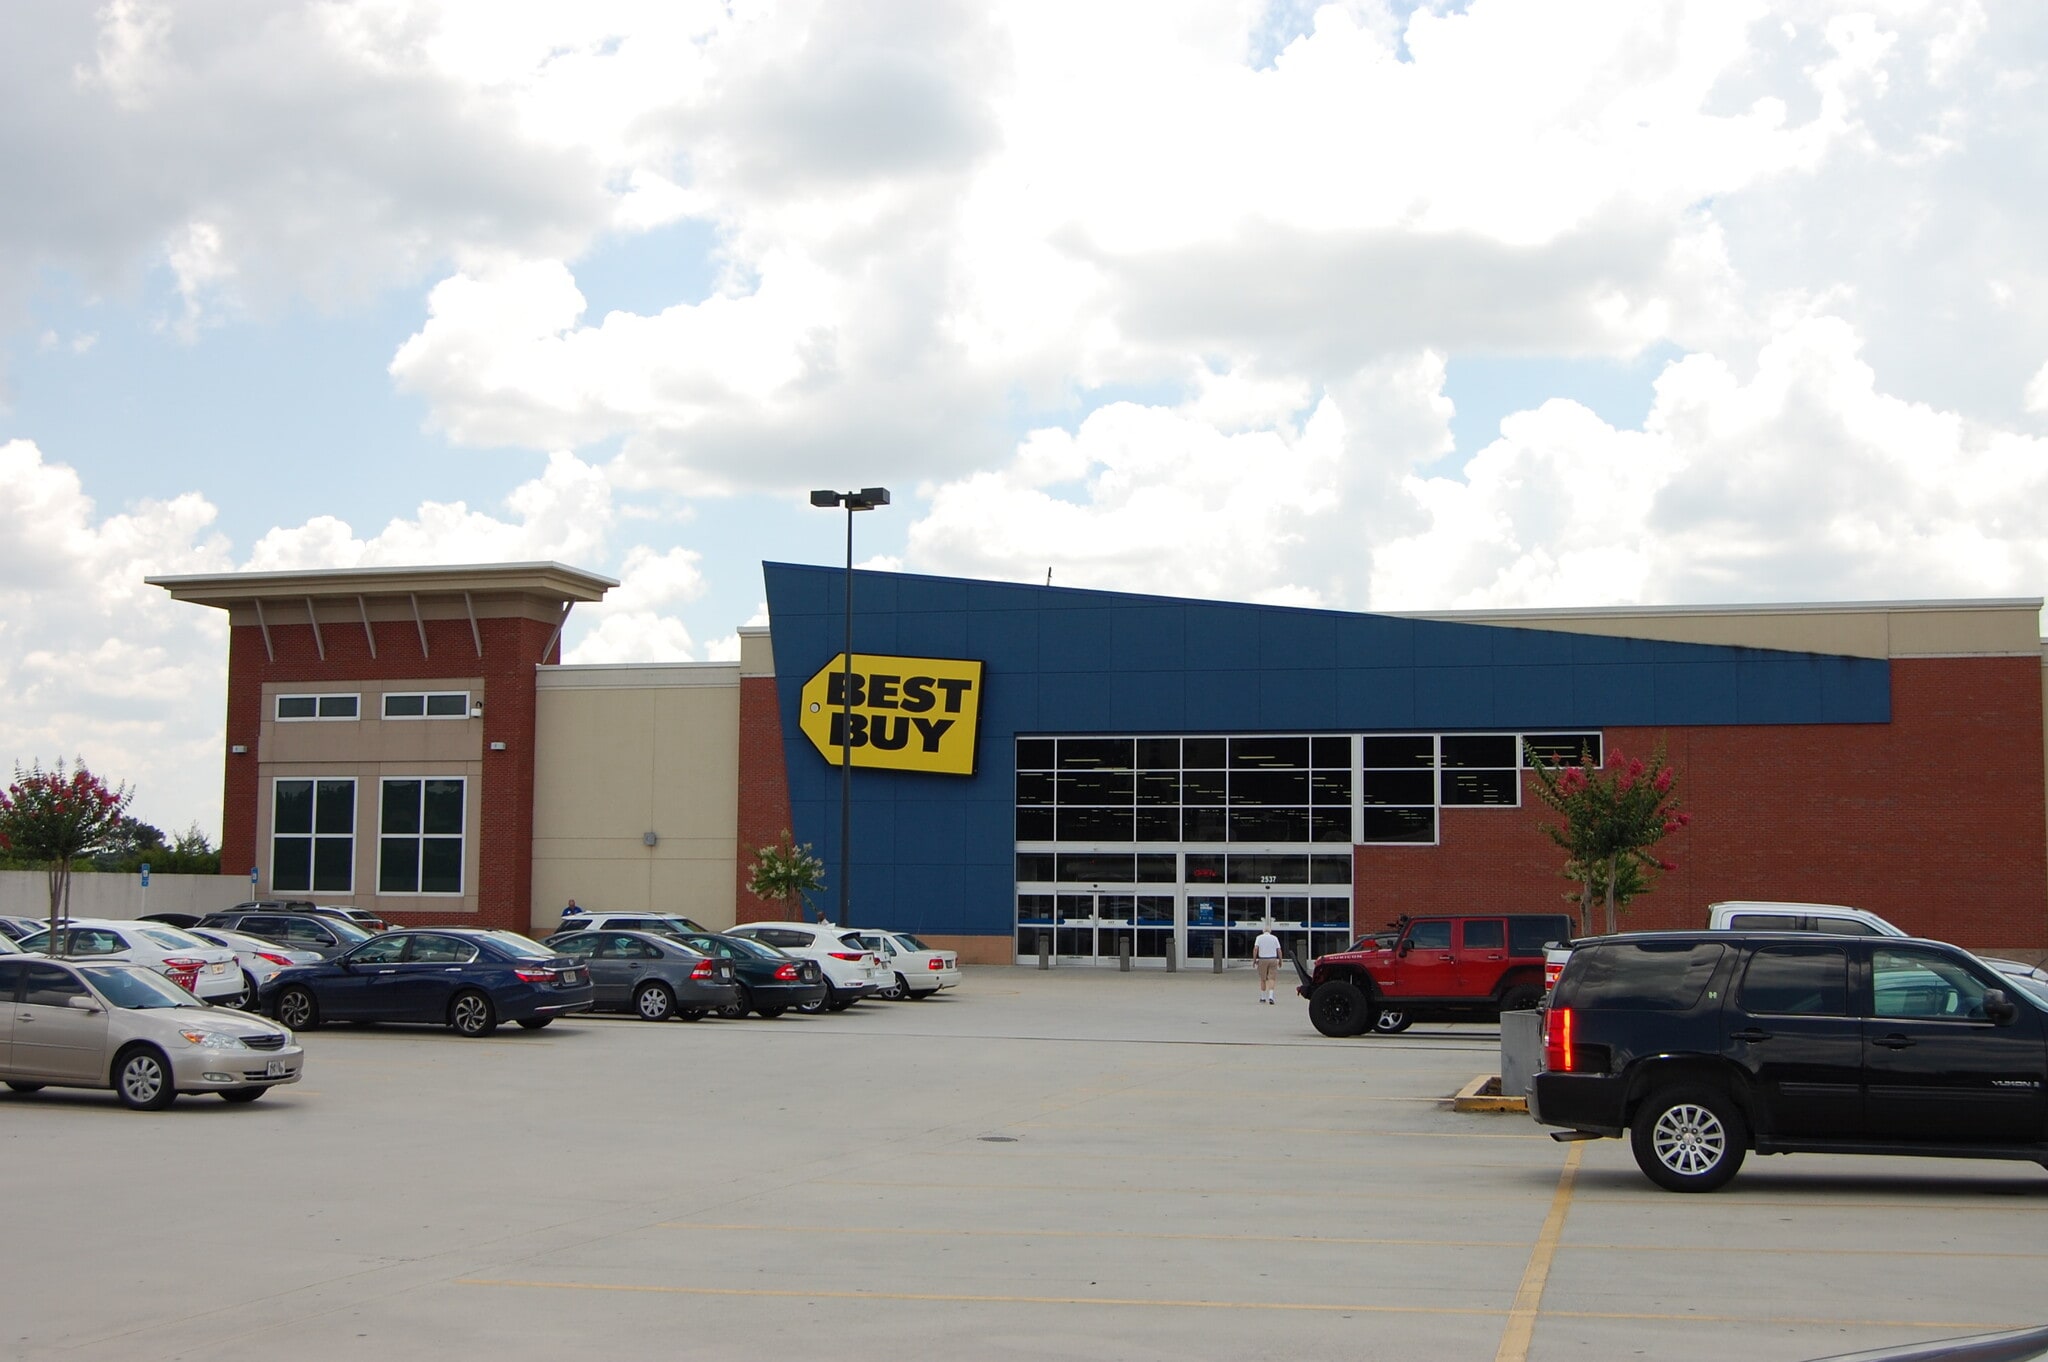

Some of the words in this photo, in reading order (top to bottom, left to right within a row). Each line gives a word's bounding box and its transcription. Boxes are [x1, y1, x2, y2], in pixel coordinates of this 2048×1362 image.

[827, 671, 972, 713] BEST
[829, 712, 956, 753] BUY
[1260, 875, 1277, 883] 2537
